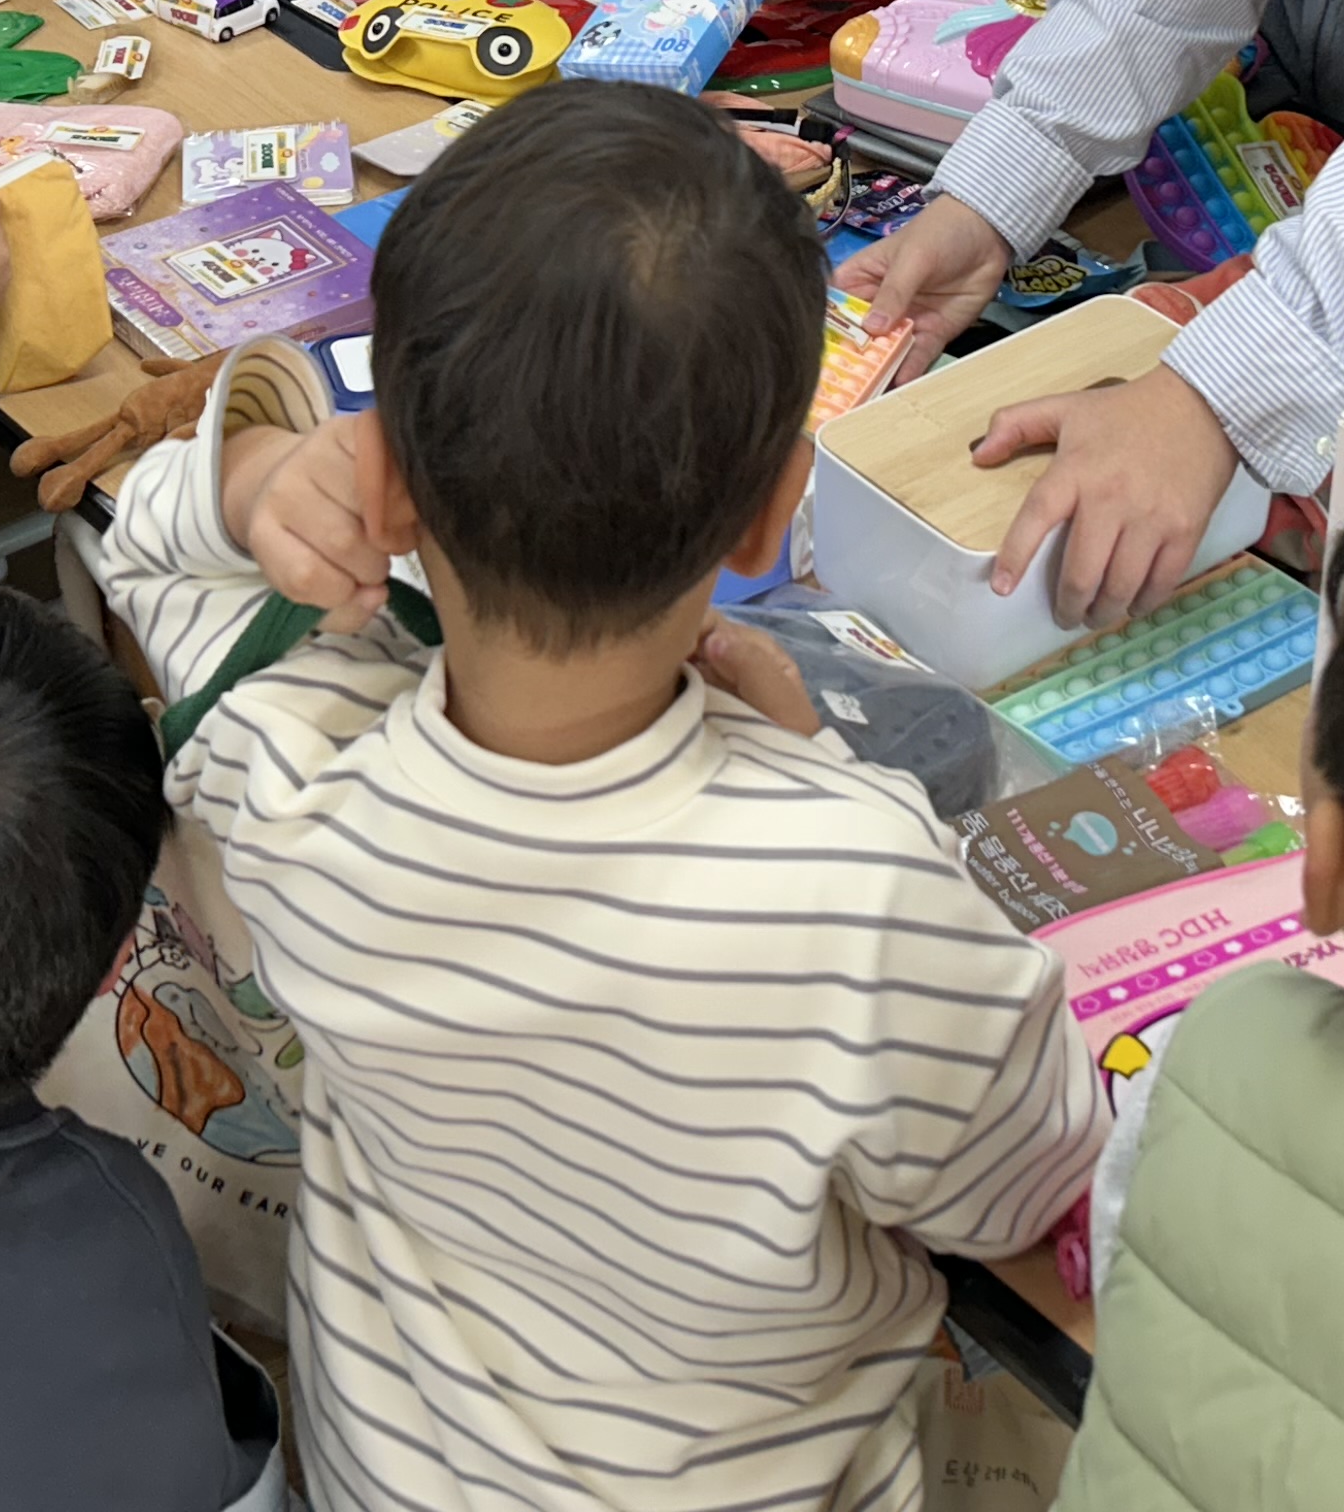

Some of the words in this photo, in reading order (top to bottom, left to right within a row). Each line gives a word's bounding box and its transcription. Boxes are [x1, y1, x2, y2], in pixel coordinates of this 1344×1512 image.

[653, 37, 690, 53] 108
[978, 835, 1037, 892] 물풍선
[1161, 907, 1233, 953] HDC
[137, 1137, 166, 1160] VE
[180, 1155, 225, 1195] OUR
[239, 1190, 289, 1220] EAR
